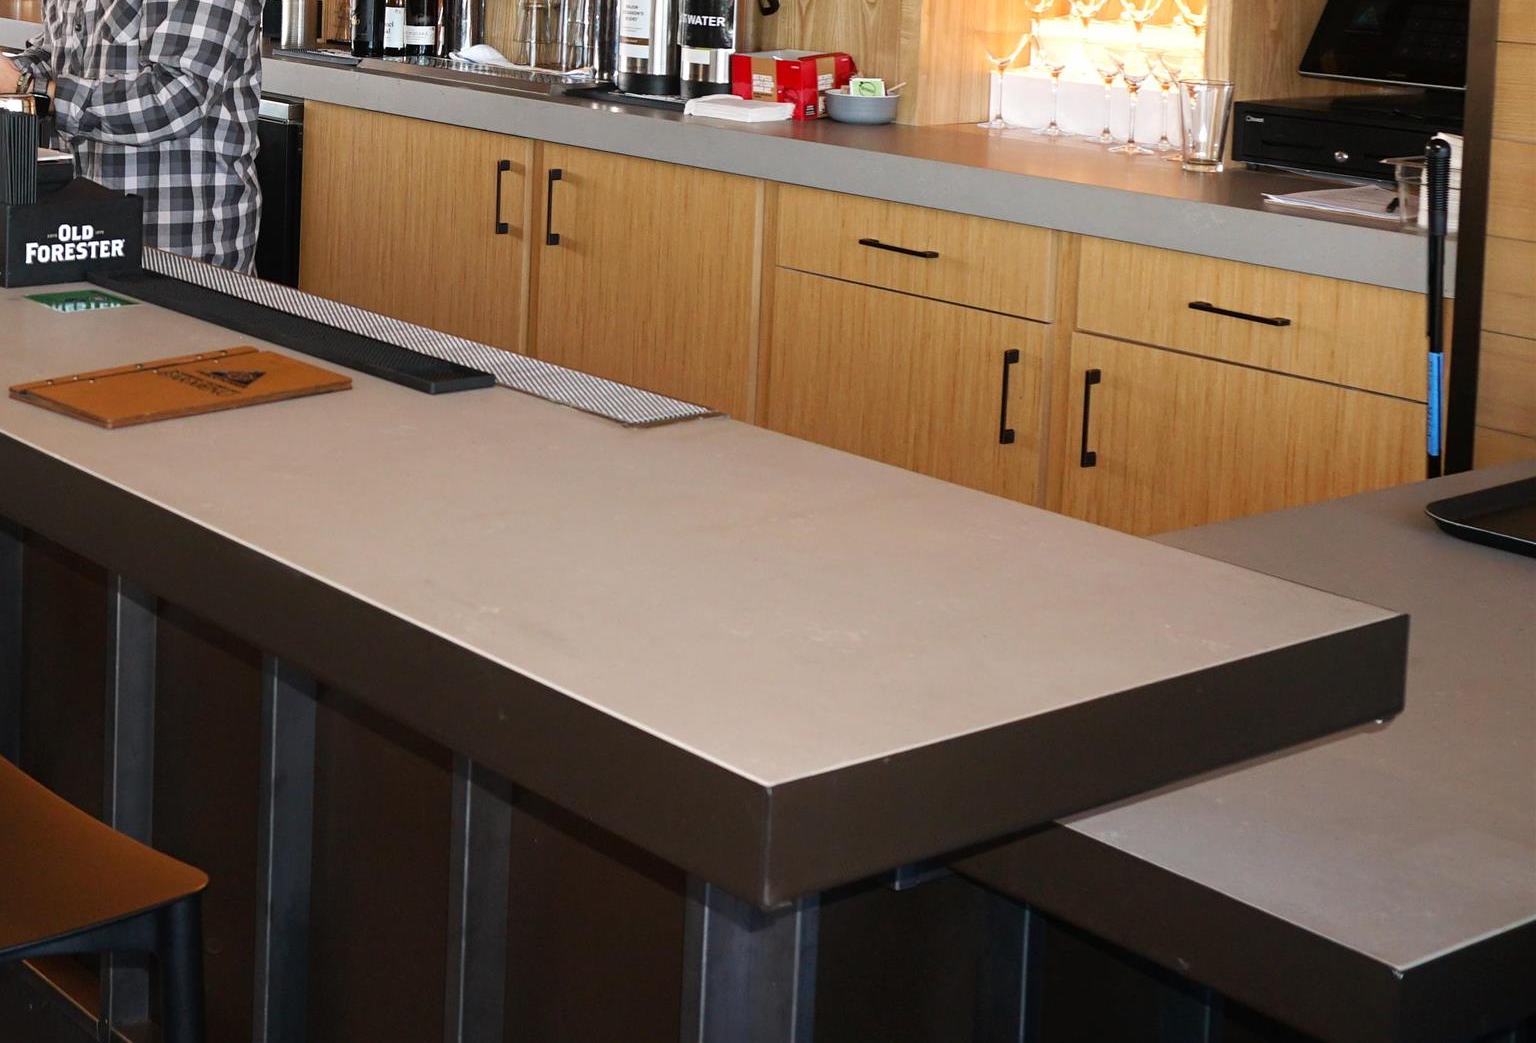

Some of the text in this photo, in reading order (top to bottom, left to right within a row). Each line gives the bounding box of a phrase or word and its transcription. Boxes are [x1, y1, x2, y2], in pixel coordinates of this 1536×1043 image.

[687, 14, 726, 27] WATER
[58, 224, 94, 242] OLD
[25, 239, 124, 264] FORESTER
